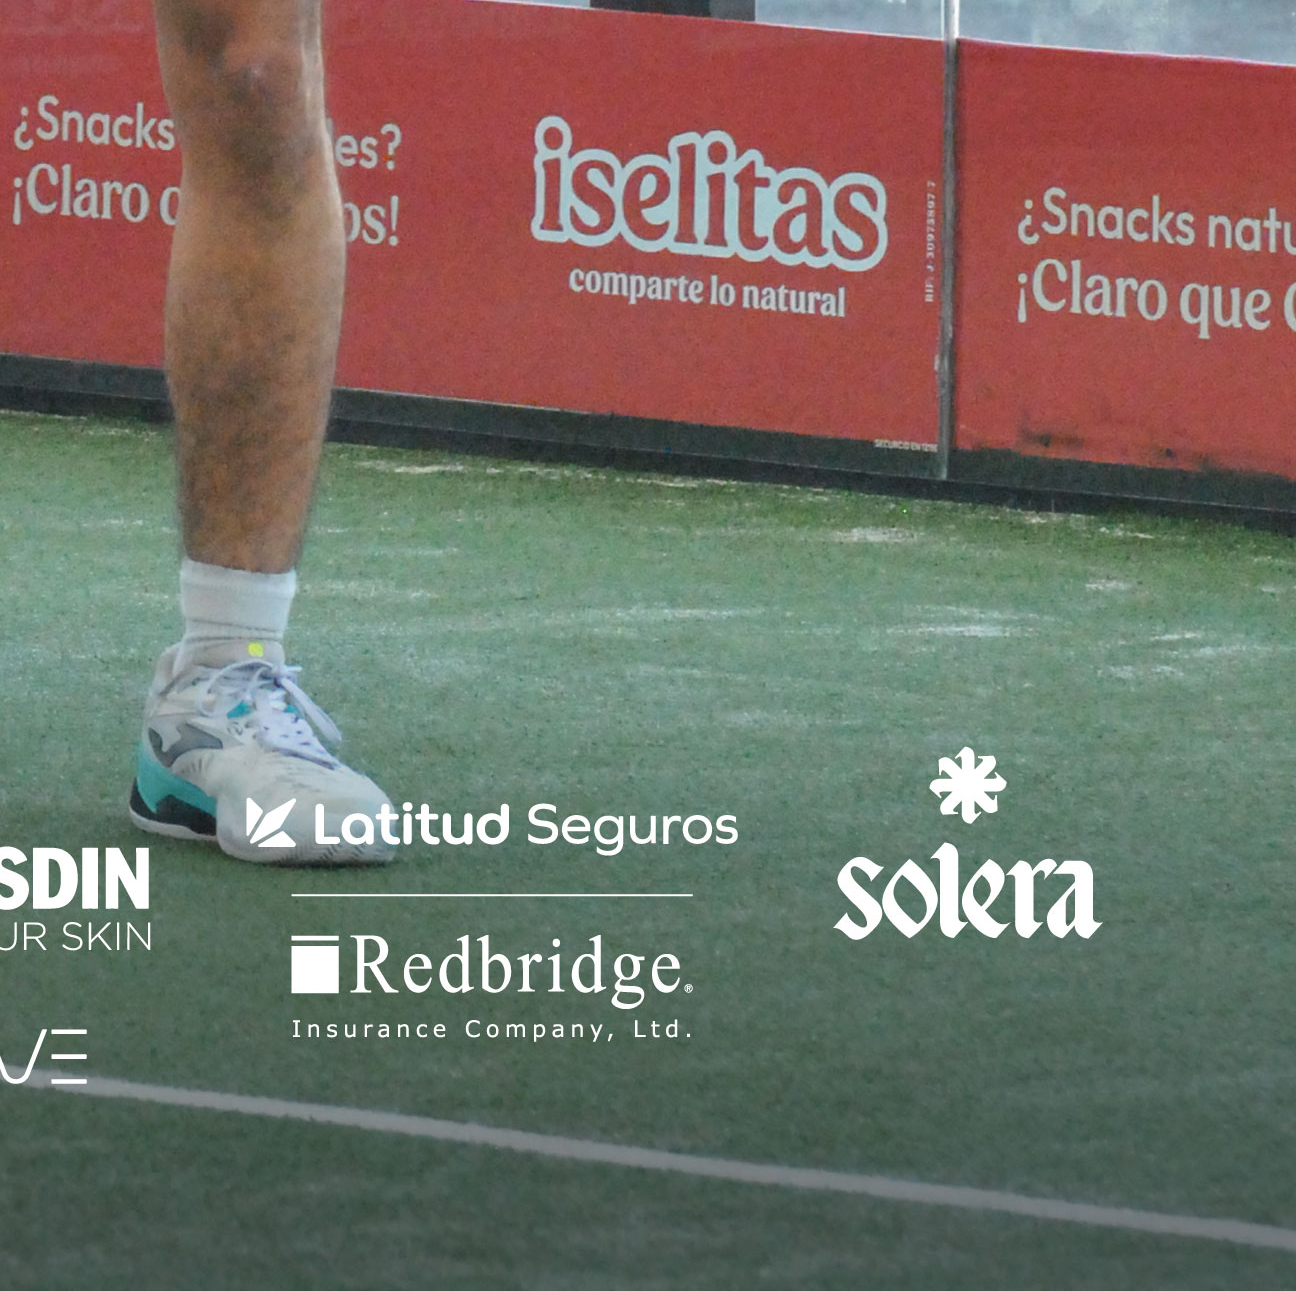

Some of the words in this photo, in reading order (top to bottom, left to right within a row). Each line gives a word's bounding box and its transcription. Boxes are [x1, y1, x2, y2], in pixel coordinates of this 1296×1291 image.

[14, 94, 175, 151] ¿Snacks
[12, 163, 150, 225] ¡Claro
[531, 115, 888, 272] iselitas
[1018, 186, 1195, 246] ¿Snacks
[569, 268, 704, 304] comparte
[710, 275, 736, 306] lo
[742, 284, 846, 317] natural
[1017, 258, 1168, 323] ¡Claro
[1179, 283, 1271, 339] que
